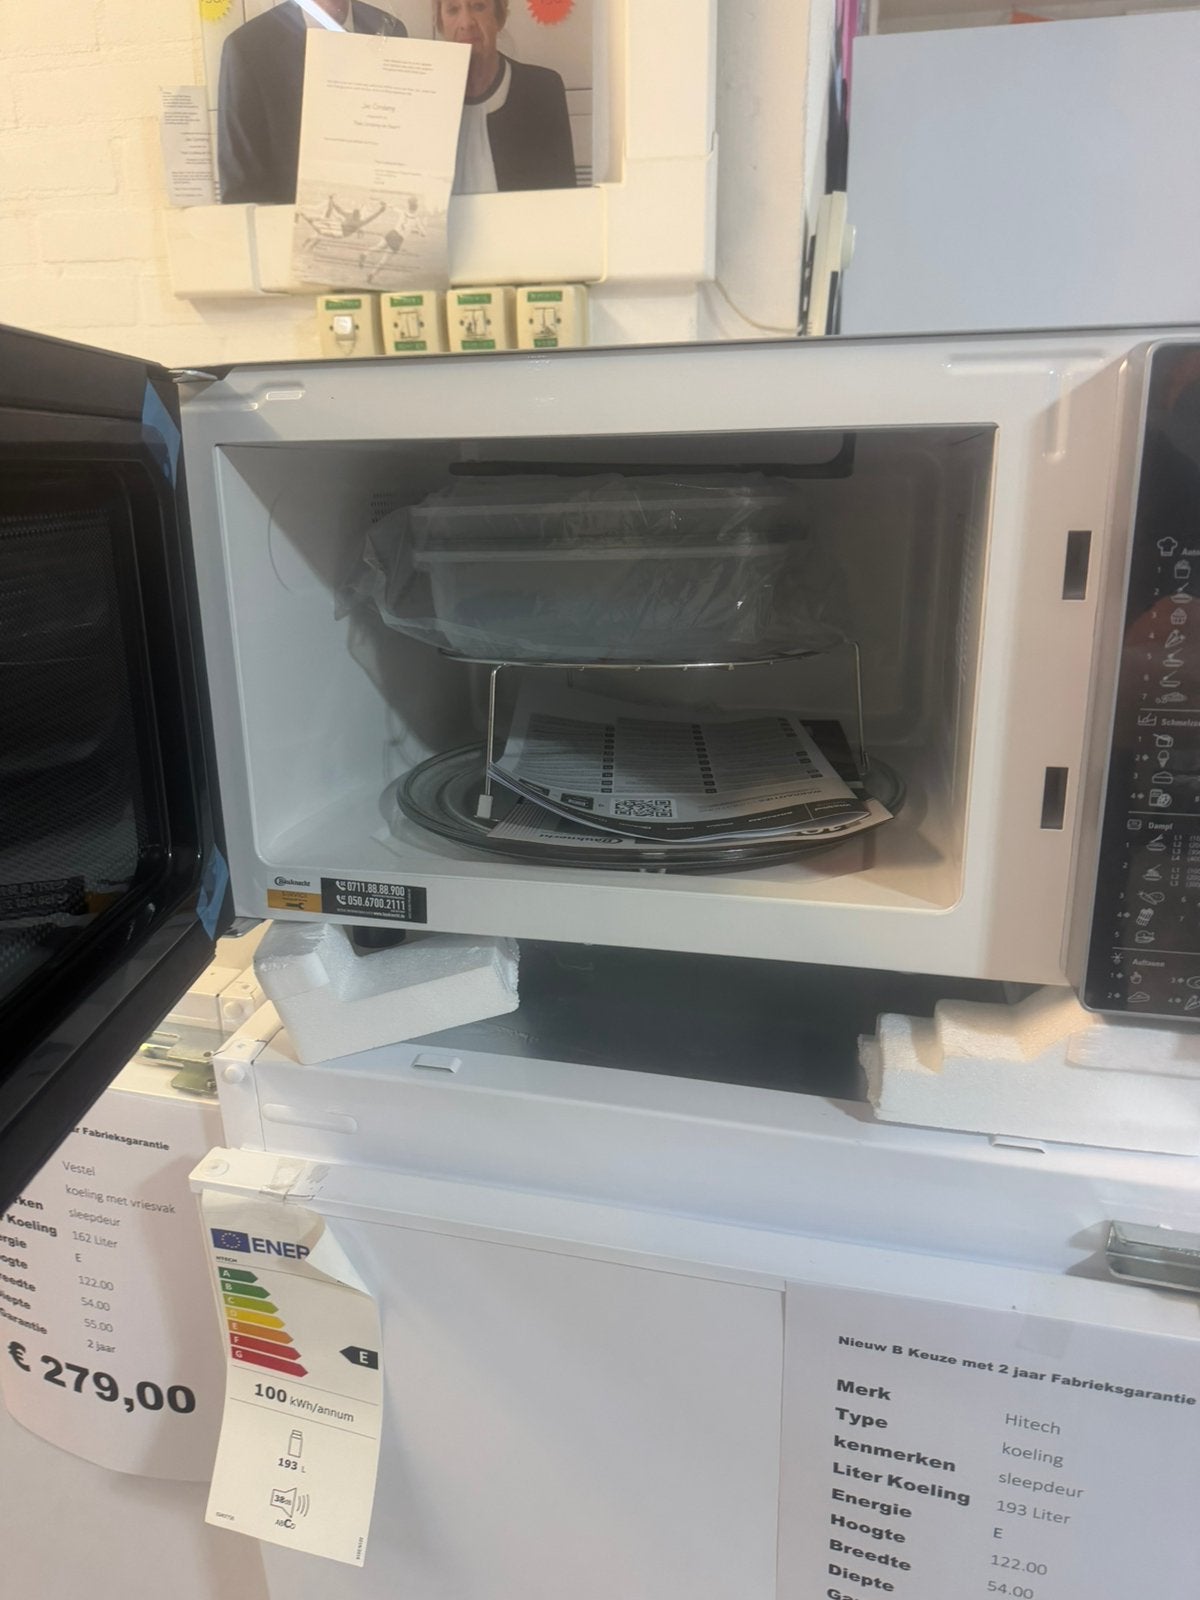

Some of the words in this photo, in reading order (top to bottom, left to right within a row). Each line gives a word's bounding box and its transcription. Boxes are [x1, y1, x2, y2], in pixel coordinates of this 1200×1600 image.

[1148, 822, 1173, 831] Dampf
[347, 881, 405, 896] 0711.88.88.900
[347, 895, 405, 911] 050.6700.2111
[82, 1127, 170, 1151] Fabrieksgarantie
[62, 1161, 96, 1177] Vestel
[65, 1184, 104, 1203] koeling
[106, 1195, 128, 1207] met
[130, 1199, 176, 1214] vriesvak
[68, 1207, 121, 1227] sleepdeur
[6, 1213, 58, 1238] Koeling
[72, 1231, 92, 1244] 162
[93, 1235, 118, 1249] Liter
[75, 1253, 82, 1263] E
[77, 1275, 114, 1292] 122.00
[80, 1296, 111, 1312] 54.00
[83, 1317, 113, 1333] 55.00
[87, 1339, 94, 1350] 2
[95, 1340, 116, 1354] jaar
[359, 1351, 368, 1364] E
[7, 1341, 31, 1373] €
[40, 1354, 197, 1415] 279,00
[838, 1335, 887, 1352] Nieuw
[892, 1345, 903, 1355] B
[908, 1348, 957, 1365] Keuze
[962, 1357, 994, 1372] met
[998, 1363, 1009, 1374] 2
[1012, 1366, 1047, 1381] jaar
[1051, 1373, 1197, 1405] Fabrieksgarantie
[254, 1383, 287, 1403] 100
[289, 1396, 354, 1423] kWh/annum
[836, 1379, 892, 1401] Merk
[1005, 1413, 1061, 1435] Hitech
[835, 1407, 888, 1429] Type
[1001, 1441, 1064, 1468] koeling
[278, 1457, 298, 1471] 193
[833, 1435, 956, 1472] kenmerken
[999, 1472, 1084, 1499] sleepdeur
[832, 1462, 882, 1484] Liter
[887, 1474, 971, 1506] Koeling
[996, 1500, 1027, 1517] 193
[1032, 1507, 1071, 1525] Liter
[831, 1488, 912, 1519] Energie
[993, 1527, 1003, 1539] E
[830, 1513, 906, 1544] Hoogte
[990, 1554, 1048, 1576] 122.00
[828, 1563, 895, 1593] Diepte
[829, 1538, 911, 1571] Breedte
[987, 1580, 1034, 1600] 54.00
